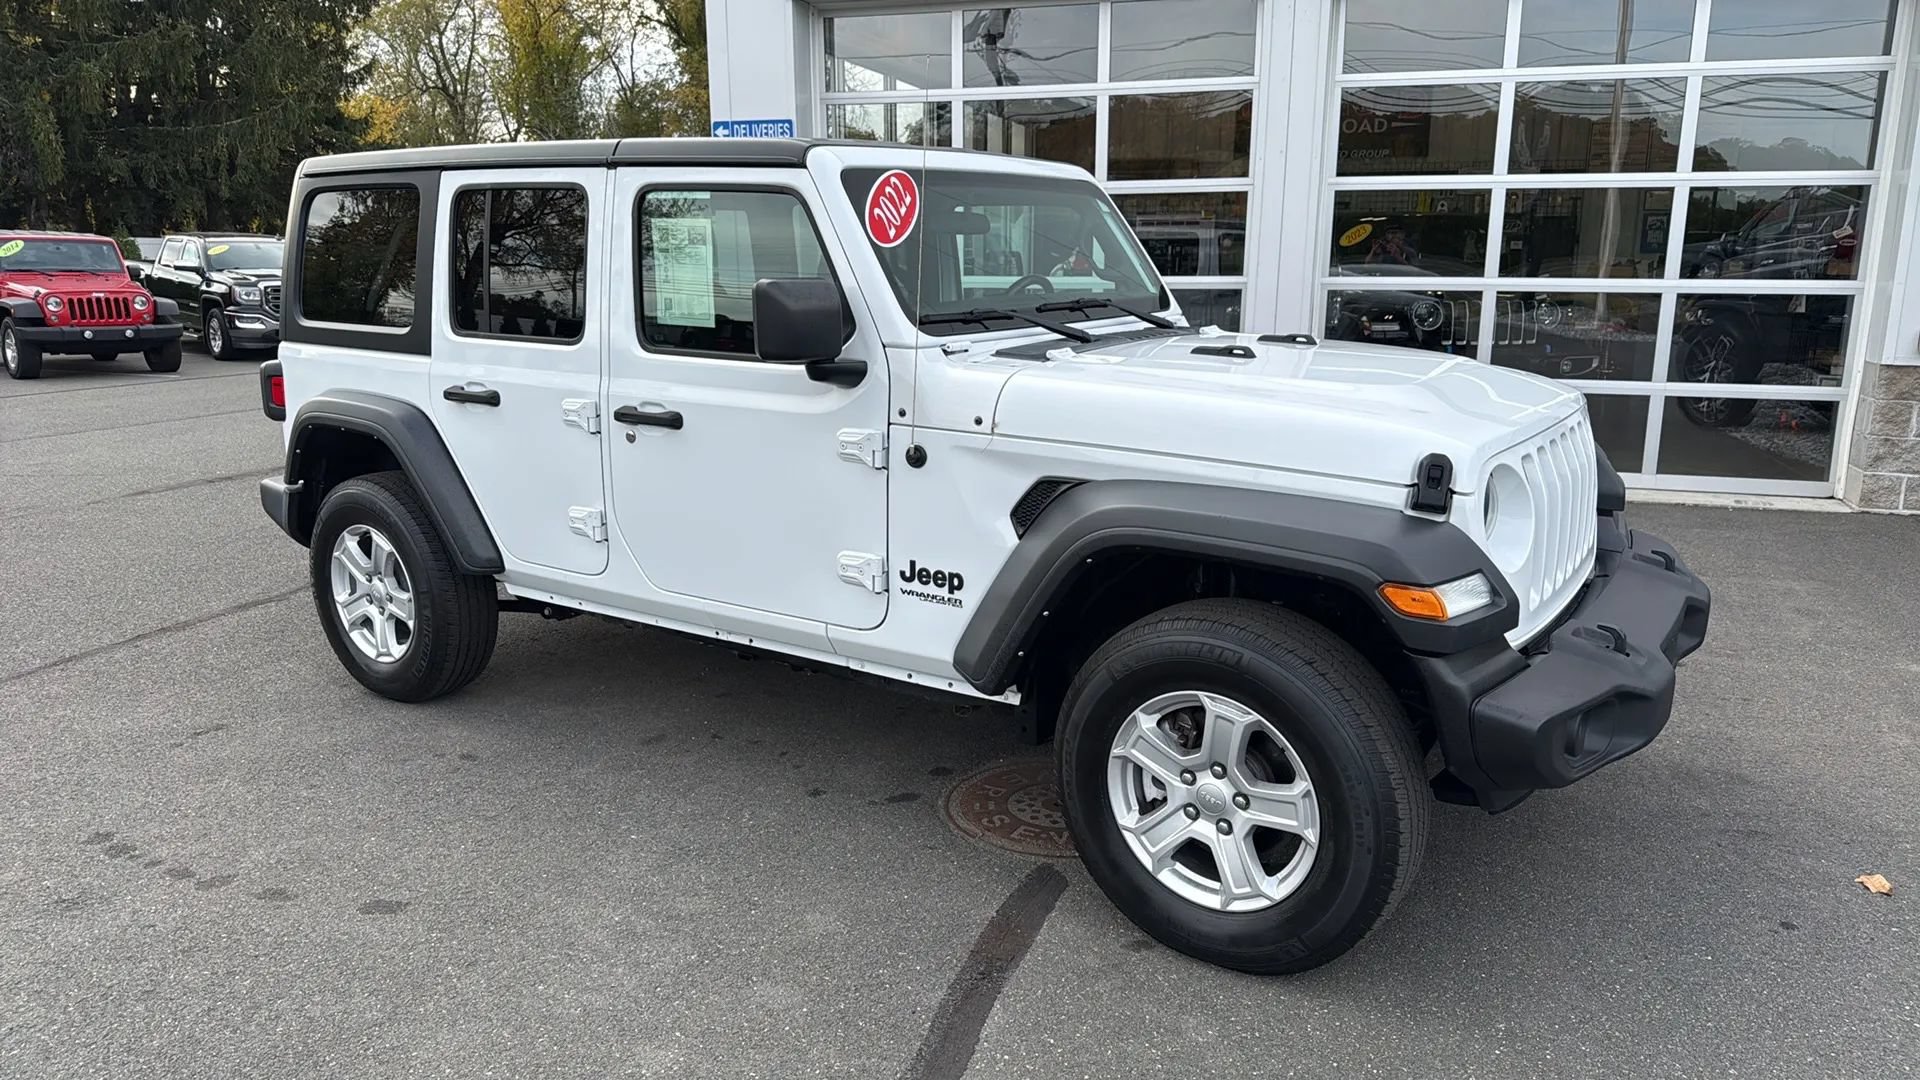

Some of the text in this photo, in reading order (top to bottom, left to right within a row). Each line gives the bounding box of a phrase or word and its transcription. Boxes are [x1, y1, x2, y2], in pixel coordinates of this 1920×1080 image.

[733, 123, 790, 138] DELIVERIES
[1350, 148, 1390, 159] GROUP
[873, 176, 912, 240] 2022
[1344, 225, 1368, 244] 2023
[2, 241, 19, 255] 2014
[899, 559, 965, 595] Jeep
[899, 587, 963, 606] WRANGLER
